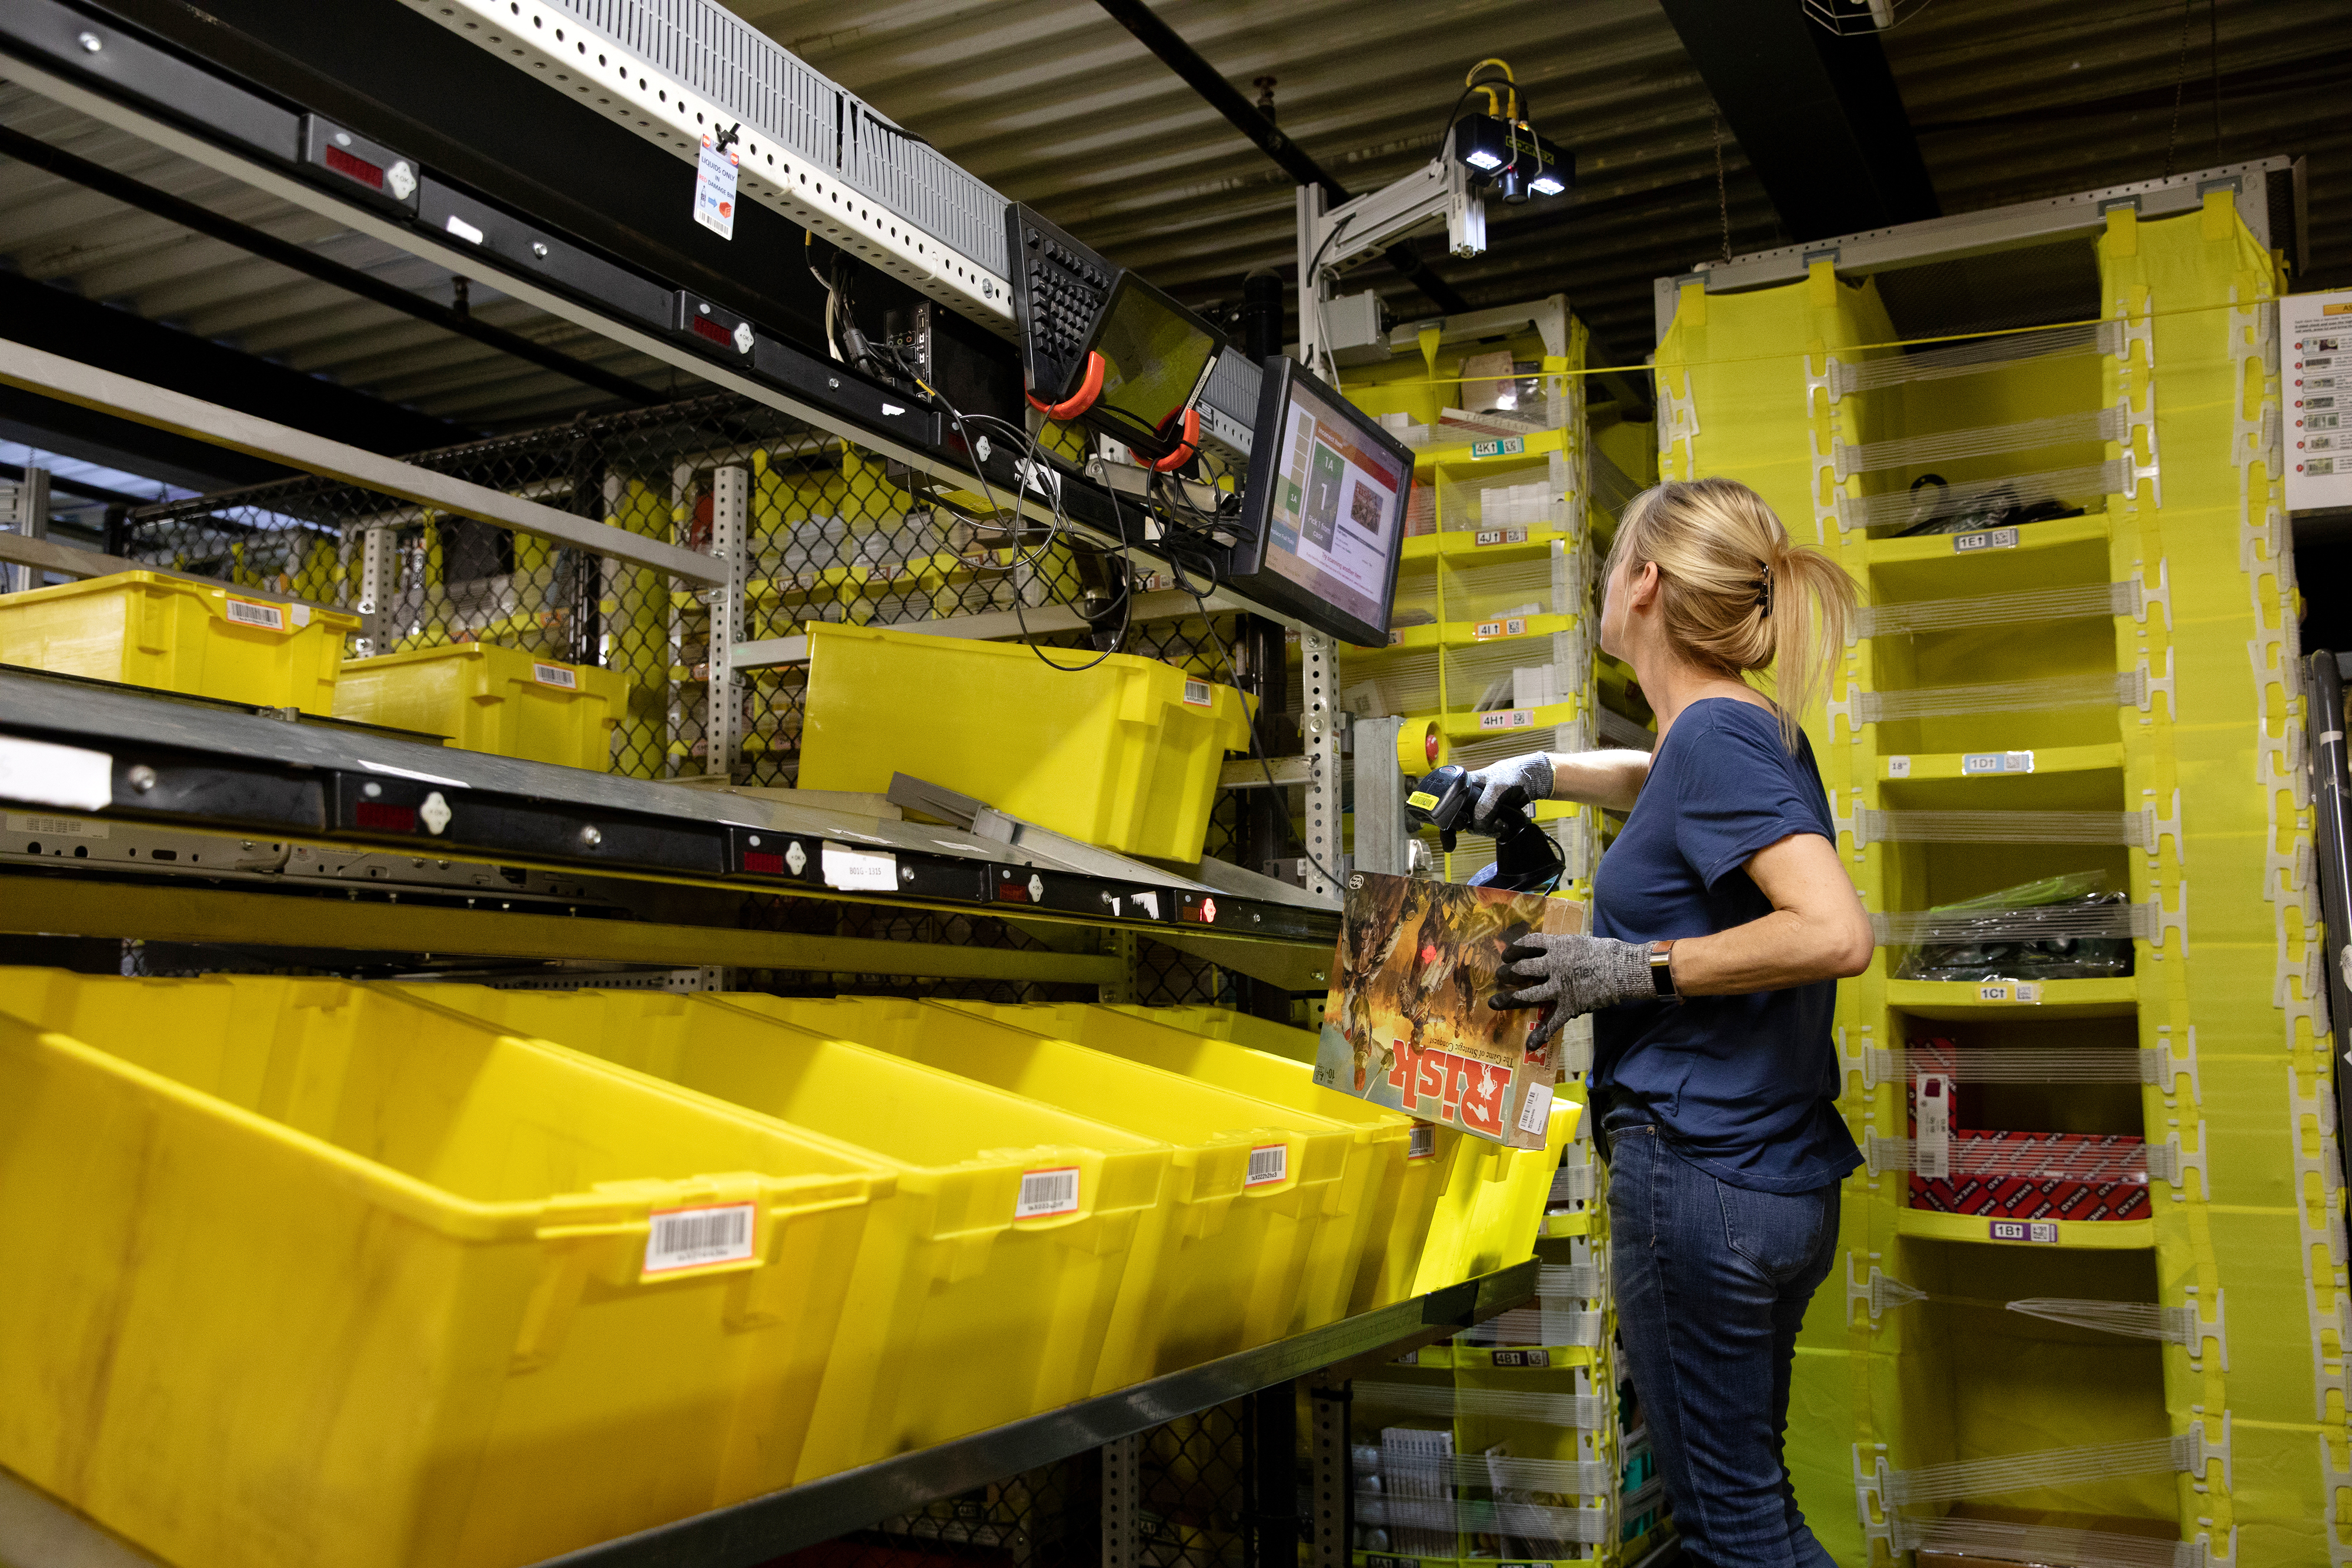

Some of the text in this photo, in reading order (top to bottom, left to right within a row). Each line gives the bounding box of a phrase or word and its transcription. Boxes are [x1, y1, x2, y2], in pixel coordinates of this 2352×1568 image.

[701, 156, 735, 182] LIQUIDS ONLY
[699, 173, 735, 200] RED DAMAGE BIN
[1318, 426, 1334, 443] Incorrect
[1477, 443, 1490, 453] 4K
[1325, 456, 1334, 472] 1A
[1291, 493, 1297, 503] 1A
[1321, 483, 1328, 511] 1
[1308, 514, 1318, 526] Pick
[1321, 523, 1331, 535] from
[1313, 530, 1324, 541] case
[1480, 533, 1491, 542] 4J
[1960, 536, 1976, 548] 1E
[1328, 556, 1342, 571] scanning
[1482, 626, 1491, 634] 4I
[1484, 716, 1498, 726] 4H
[1972, 758, 1987, 769] 1D
[1560, 965, 1596, 990] HyFlex
[1982, 989, 1998, 998] 1C
[1429, 1038, 1514, 1068] The Game of Strategic Conquest
[1546, 1044, 1555, 1061] Game
[1326, 1068, 1335, 1079] 10+
[1388, 1039, 1514, 1139] Risk
[2006, 1183, 2033, 1208] SMEAD
[2061, 1187, 2088, 1212] SMEAD
[2117, 1190, 2146, 1215] SMEAD
[1998, 1226, 2014, 1235] 1B
[1498, 1354, 1512, 1363] 4B
